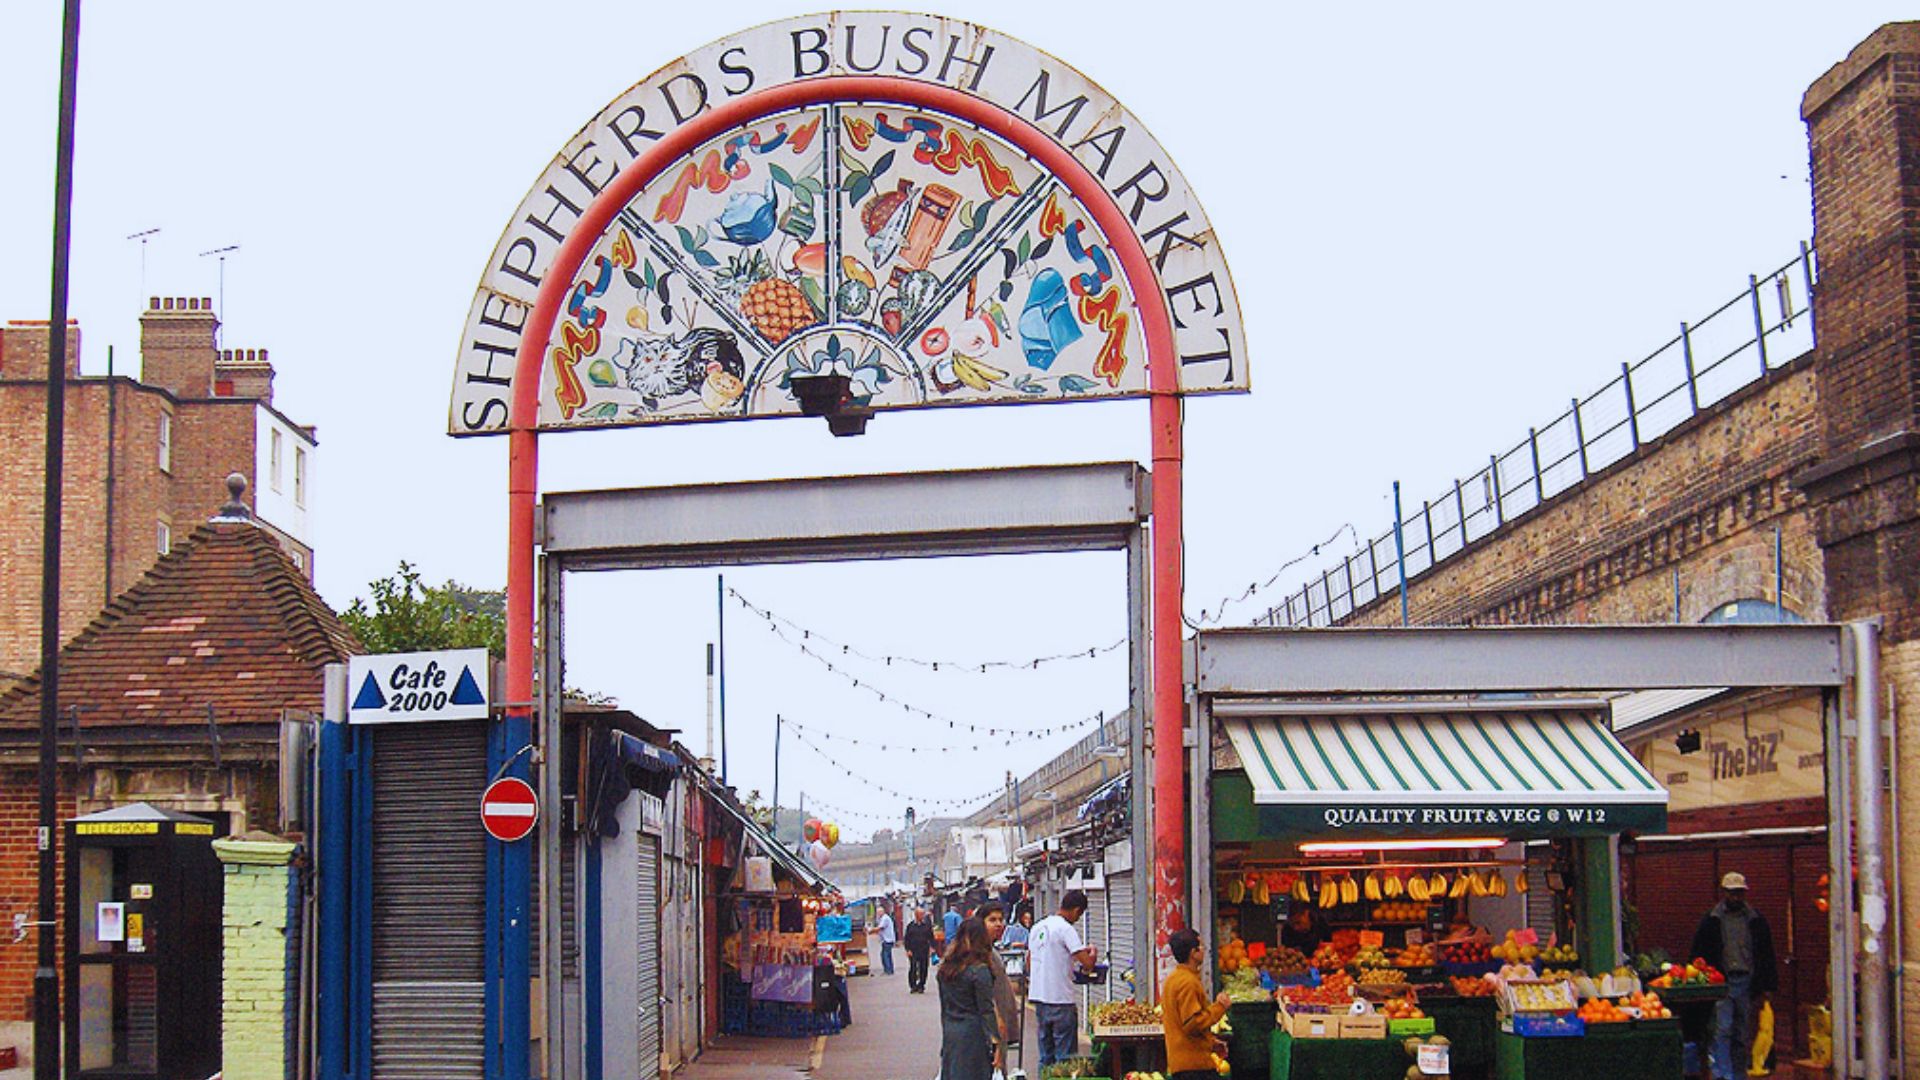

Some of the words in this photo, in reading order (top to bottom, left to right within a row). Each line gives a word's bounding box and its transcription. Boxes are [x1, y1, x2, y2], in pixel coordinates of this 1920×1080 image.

[463, 47, 755, 430] SHEPHERDS
[790, 26, 995, 92] BUSH
[1013, 69, 1235, 384] MARKET
[389, 660, 447, 690] Cafe
[388, 691, 448, 713] 2000
[1324, 808, 1416, 828] QUALITY
[1421, 808, 1541, 824] FRUIT&VEG
[1566, 808, 1606, 823] W12
